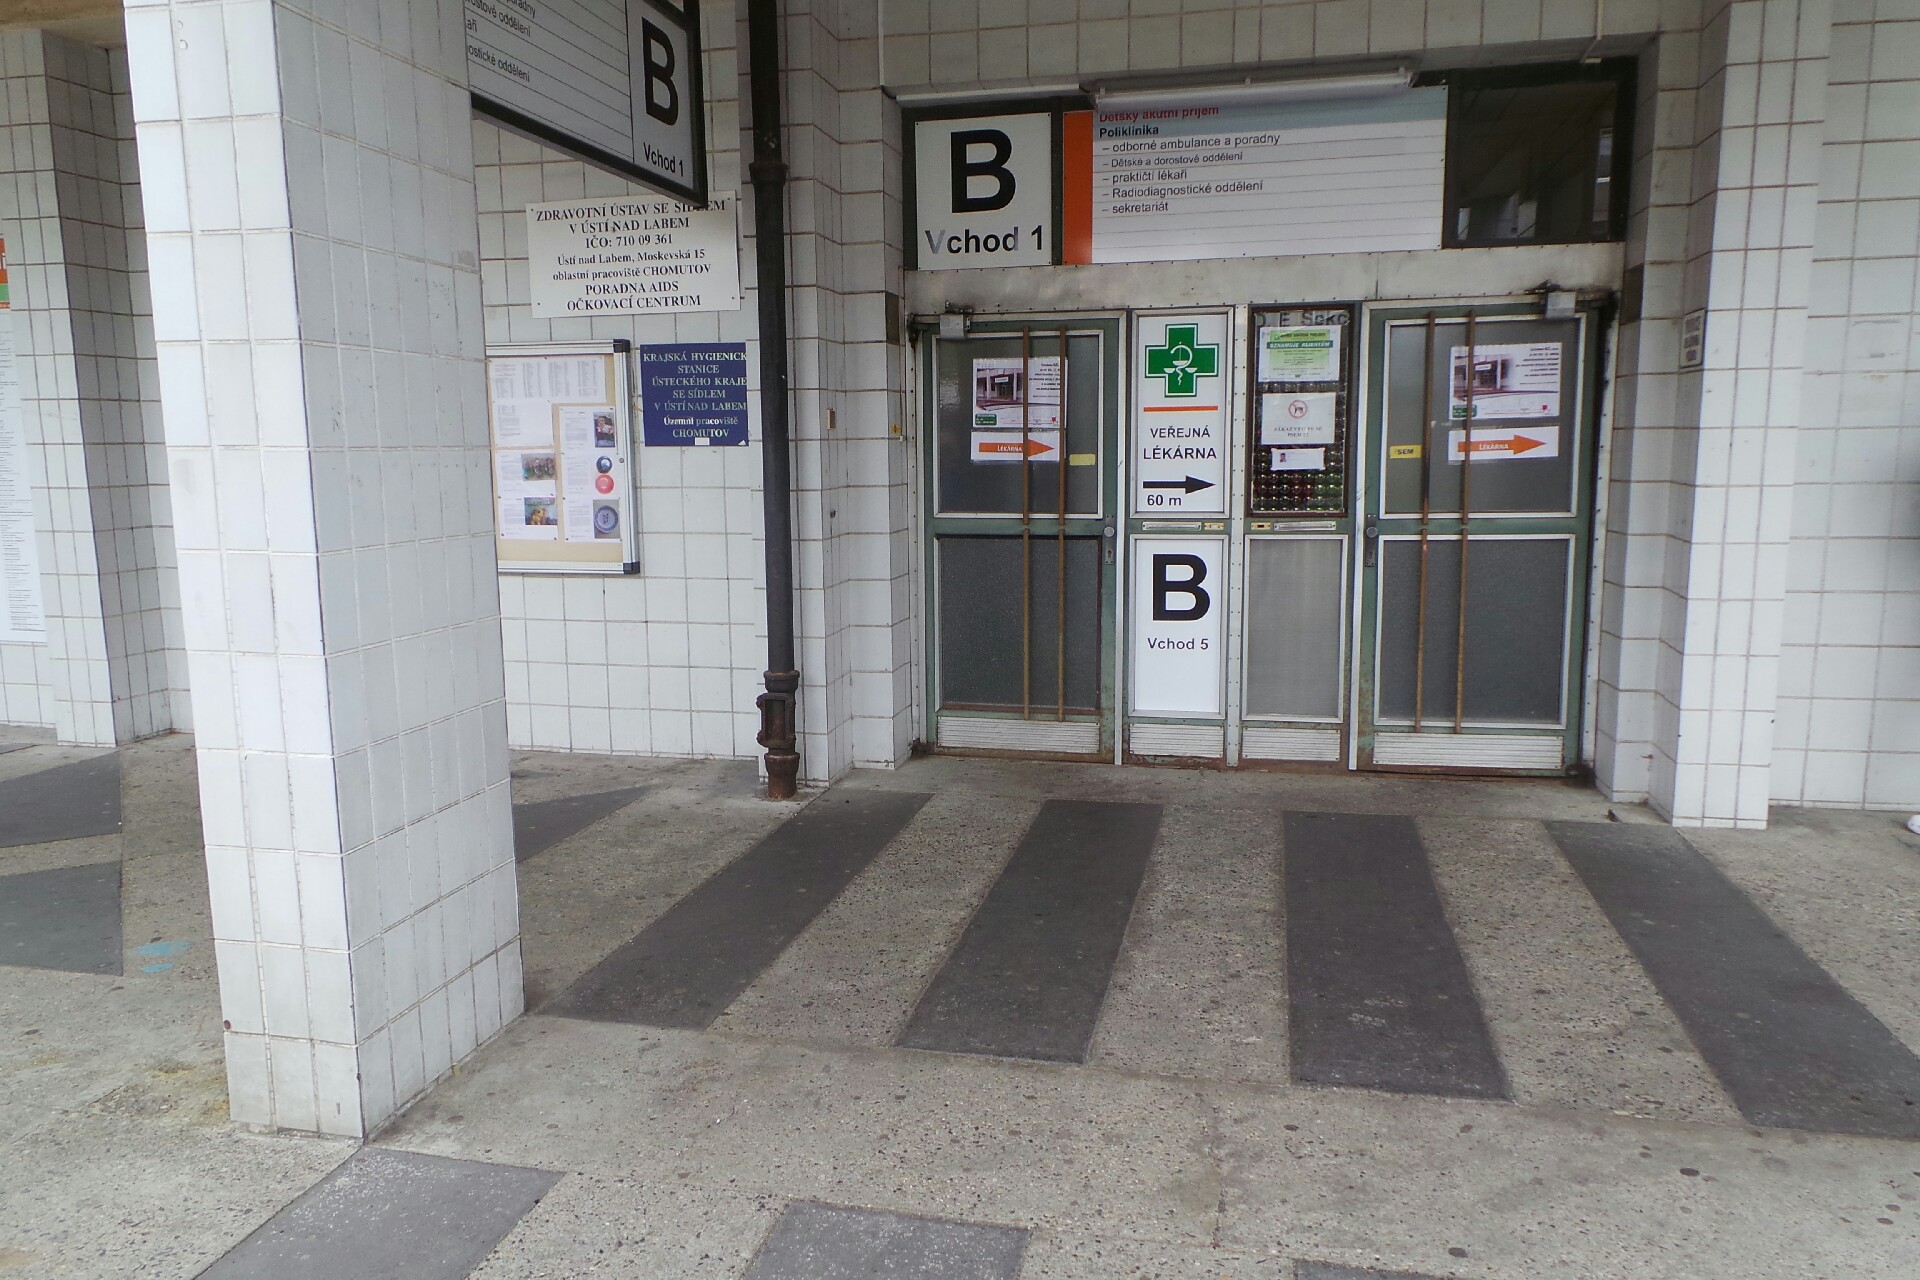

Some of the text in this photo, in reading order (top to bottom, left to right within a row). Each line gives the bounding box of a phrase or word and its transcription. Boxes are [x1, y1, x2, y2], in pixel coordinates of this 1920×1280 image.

[641, 16, 679, 126] B
[1099, 125, 1159, 138] Poliklinika
[1112, 133, 1281, 152] odborné ambulance a poradny
[643, 142, 684, 177] Vchod 1
[1111, 157, 1143, 168] Dětské
[1154, 154, 1200, 165] dorostové
[1202, 152, 1243, 163] oddělení
[950, 128, 1016, 214] B
[1158, 169, 1187, 180] lékaři
[1112, 179, 1264, 198] Radiodiagnostické oddělení
[536, 206, 607, 221] ZDRAVOTNÍ
[610, 203, 650, 217] ÚSTAV
[653, 202, 669, 214] SE
[1112, 201, 1168, 214] sekretariát
[569, 217, 690, 234] V ÚSTÍ NAD LABEM
[585, 233, 672, 249] IČO: 710 09 361
[925, 225, 1043, 254] Vchod 1
[557, 249, 705, 266] Ústí nad Labem, Moskevská 15
[552, 263, 712, 282] oblastní pracoviště CHOMUTOV
[585, 281, 679, 295] PORADNA AIDS
[567, 295, 701, 312] OČKOVACÍ CENTRUM
[643, 351, 687, 362] KRAJSKÁ
[678, 365, 720, 374] STANICE
[652, 375, 747, 386] ÚSTECKÉHO KRAJE
[672, 388, 726, 399] SE SÍDLEM
[654, 400, 747, 411] V ÚSTÍ NAD LABEM
[663, 415, 738, 427] Územní pracoviště
[672, 428, 730, 437] CHOMUTOV
[1150, 425, 1211, 439] VEŘEJNÁ
[1143, 445, 1217, 460] LÉKÁRNA
[1147, 494, 1182, 506] 60 m
[1152, 553, 1210, 621] B
[1147, 637, 1209, 650] Vchod 5
